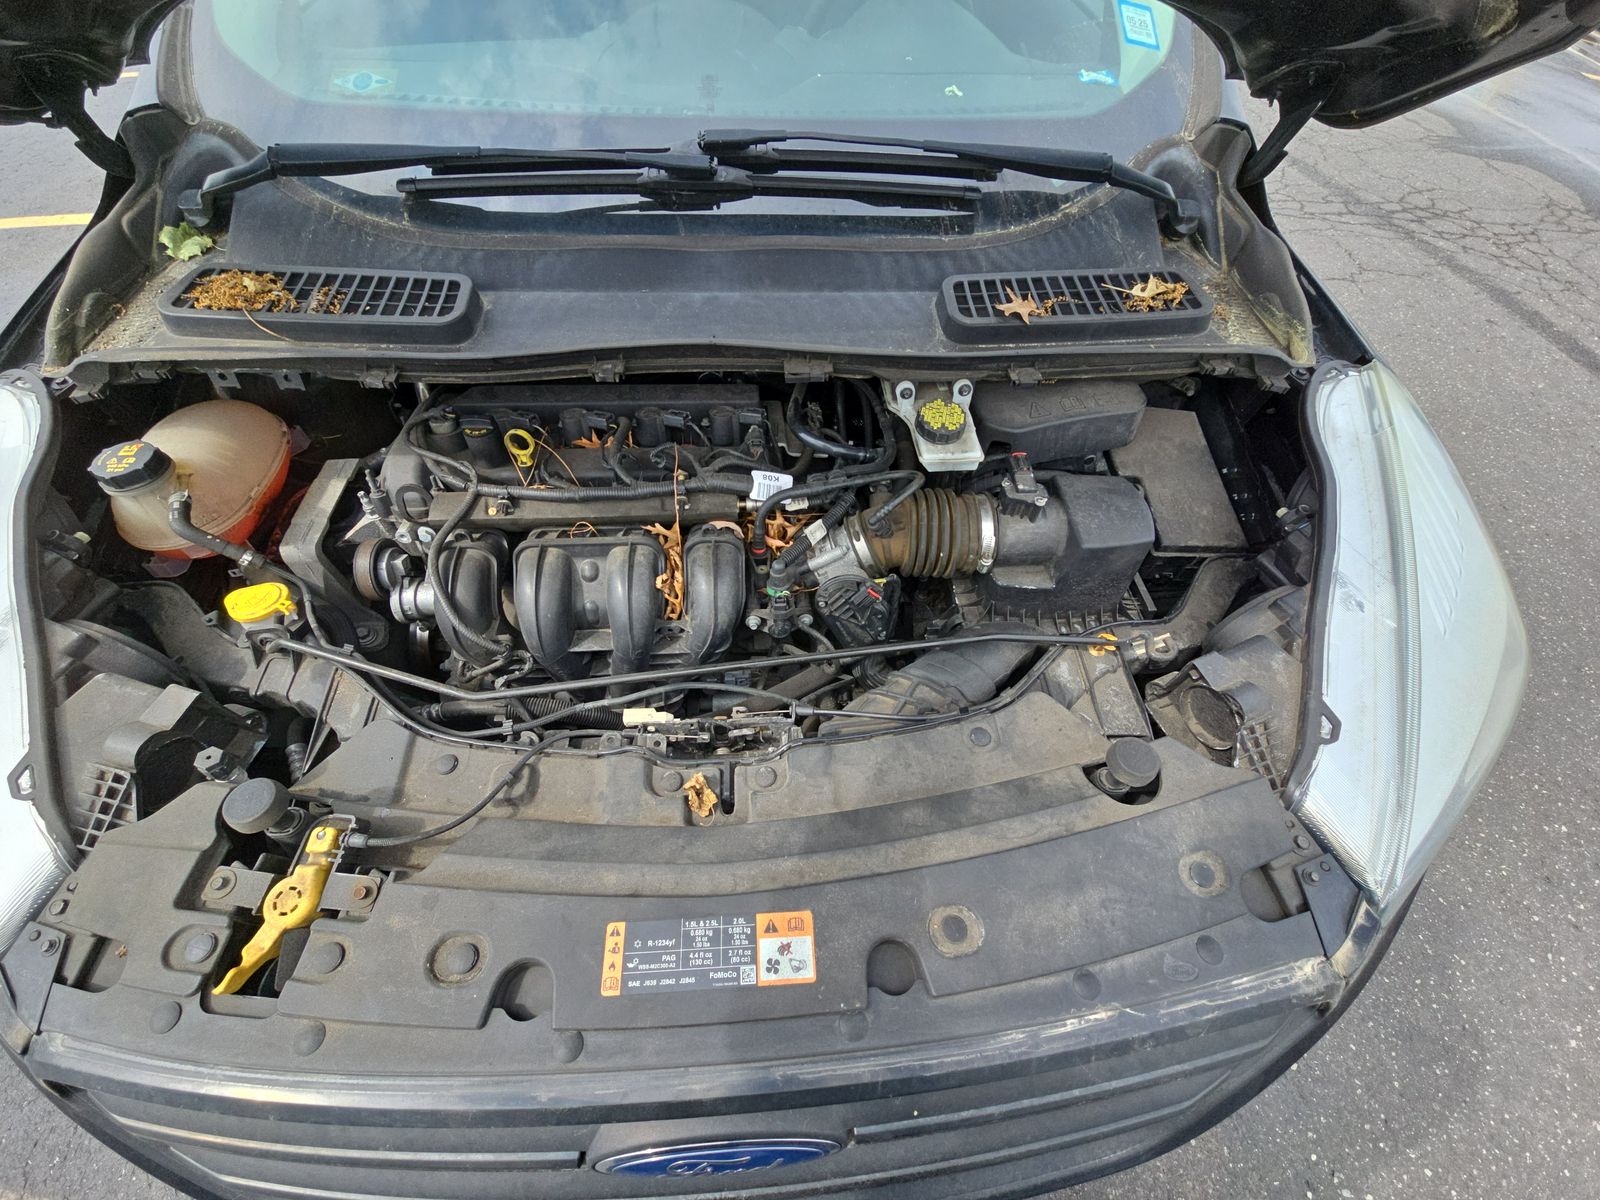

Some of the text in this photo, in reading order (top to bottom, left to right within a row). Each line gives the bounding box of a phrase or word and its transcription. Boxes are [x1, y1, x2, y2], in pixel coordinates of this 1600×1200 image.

[762, 474, 780, 483] K08
[706, 919, 719, 927] 2.5L
[733, 917, 746, 925] 2.0L
[705, 929, 713, 937] kg
[743, 926, 751, 935] kg
[647, 938, 676, 948] R-1234yf
[661, 954, 676, 962] PAG
[689, 958, 713, 967] (130 cc)
[740, 955, 751, 964] cc)
[709, 970, 737, 979] FoMoCo
[628, 980, 641, 988] SAE
